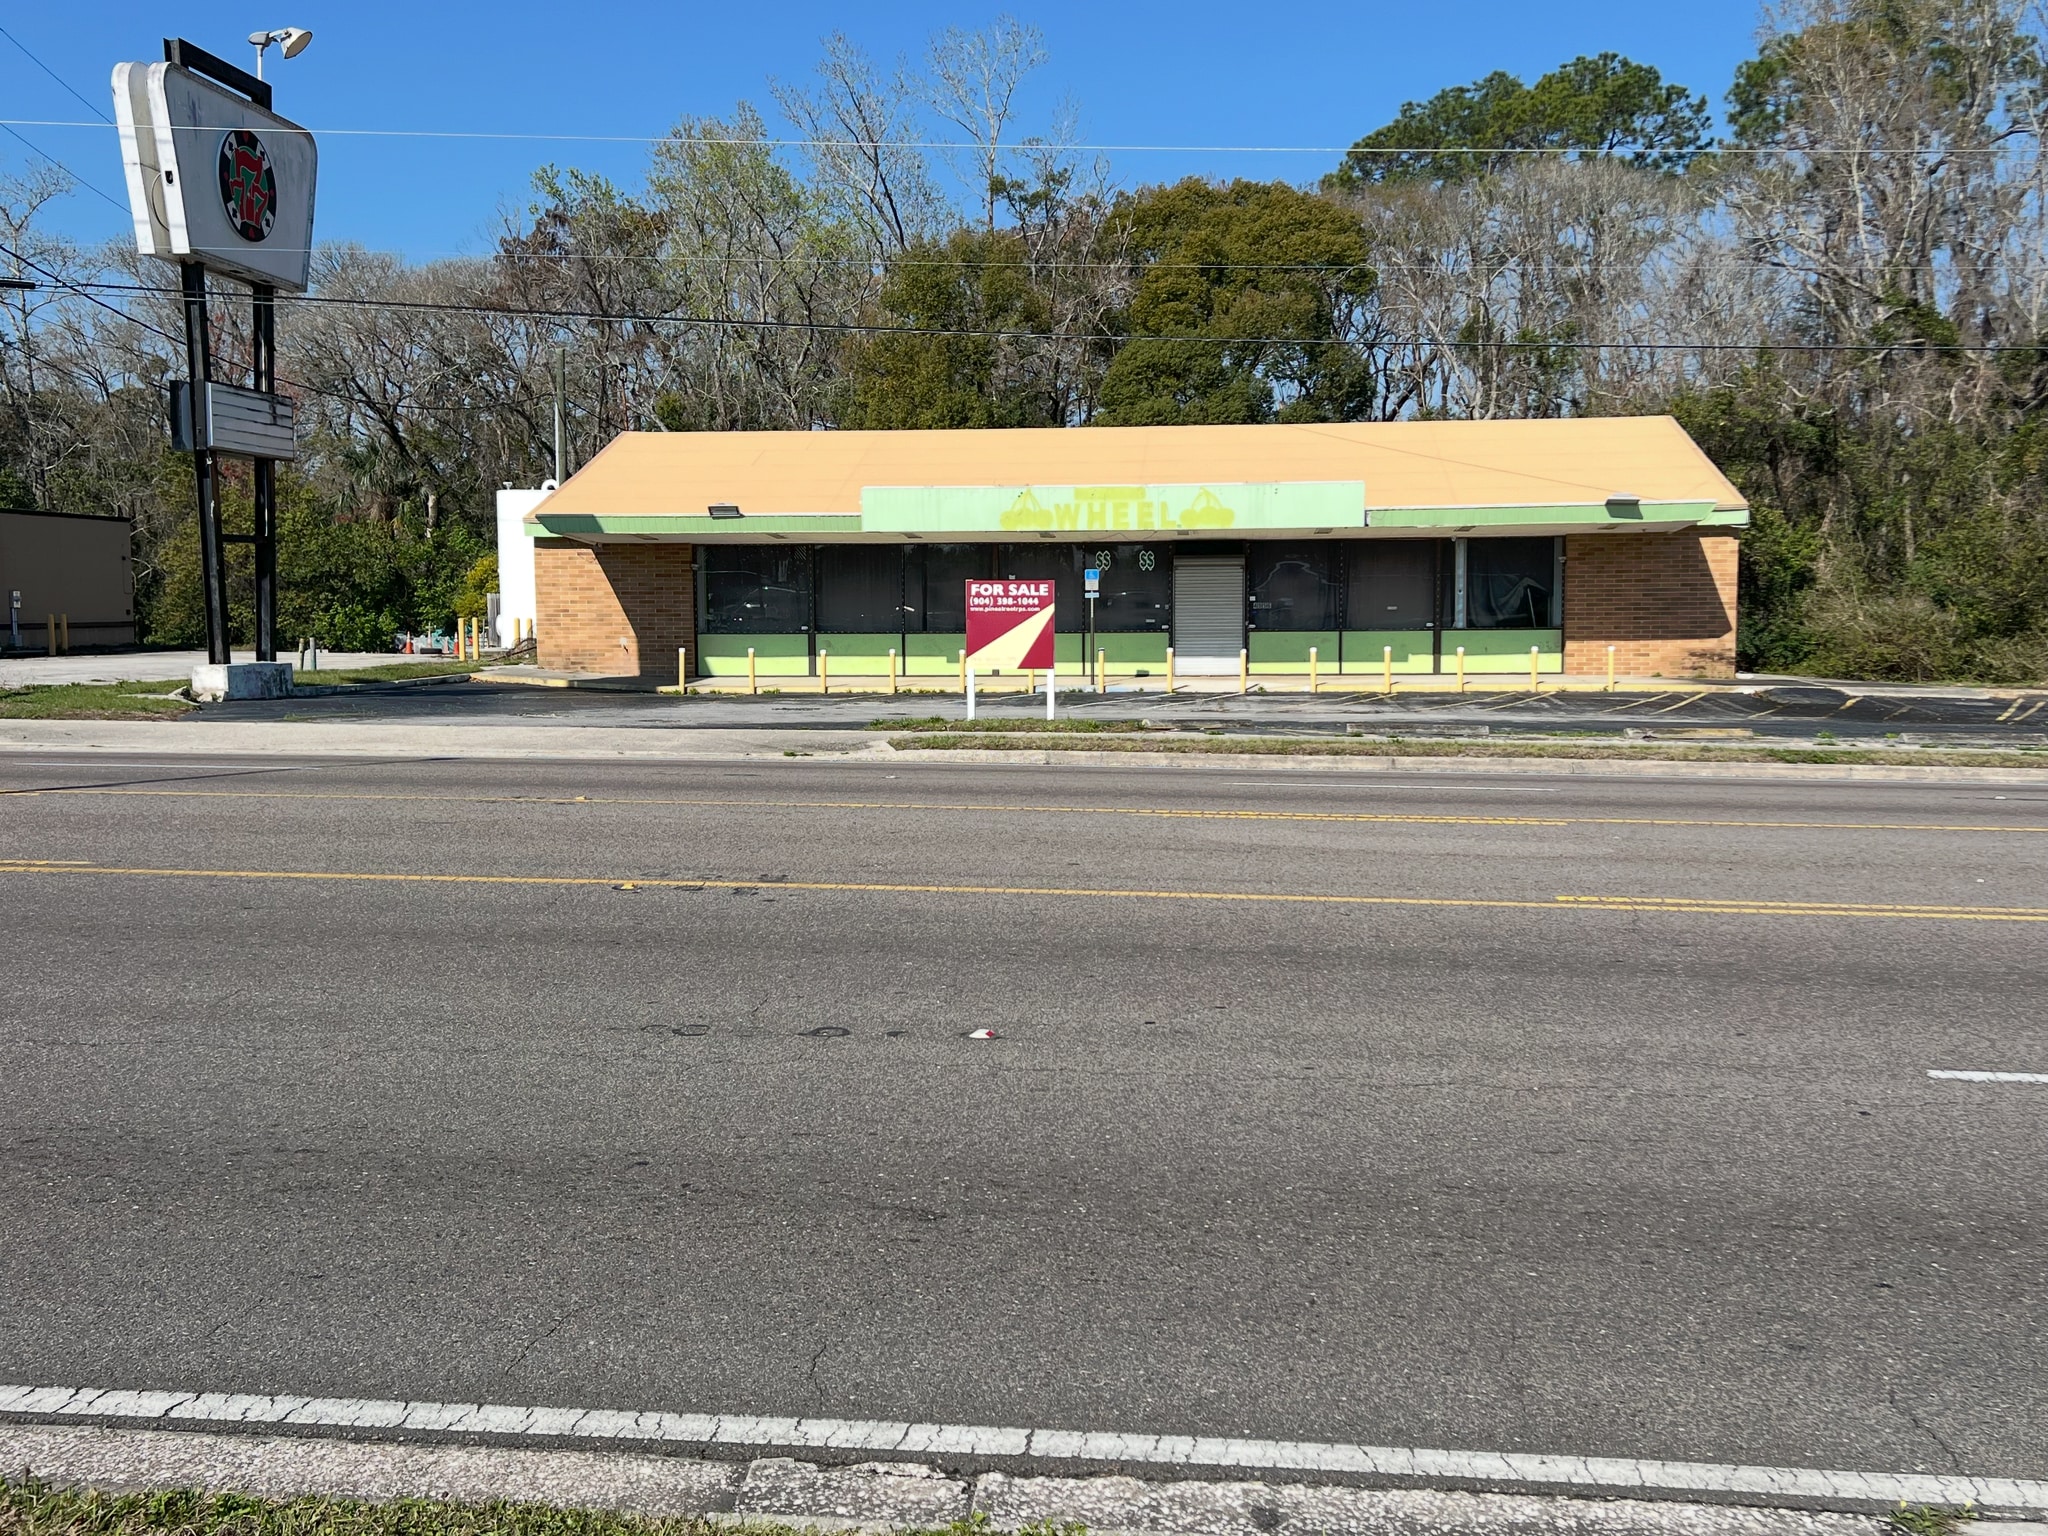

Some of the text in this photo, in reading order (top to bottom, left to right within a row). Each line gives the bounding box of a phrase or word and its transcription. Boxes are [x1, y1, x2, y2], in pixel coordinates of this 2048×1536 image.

[1054, 501, 1176, 530] WHEEL
[971, 583, 1049, 596] FOR SALE
[969, 596, 1039, 606] (904) 398-1044
